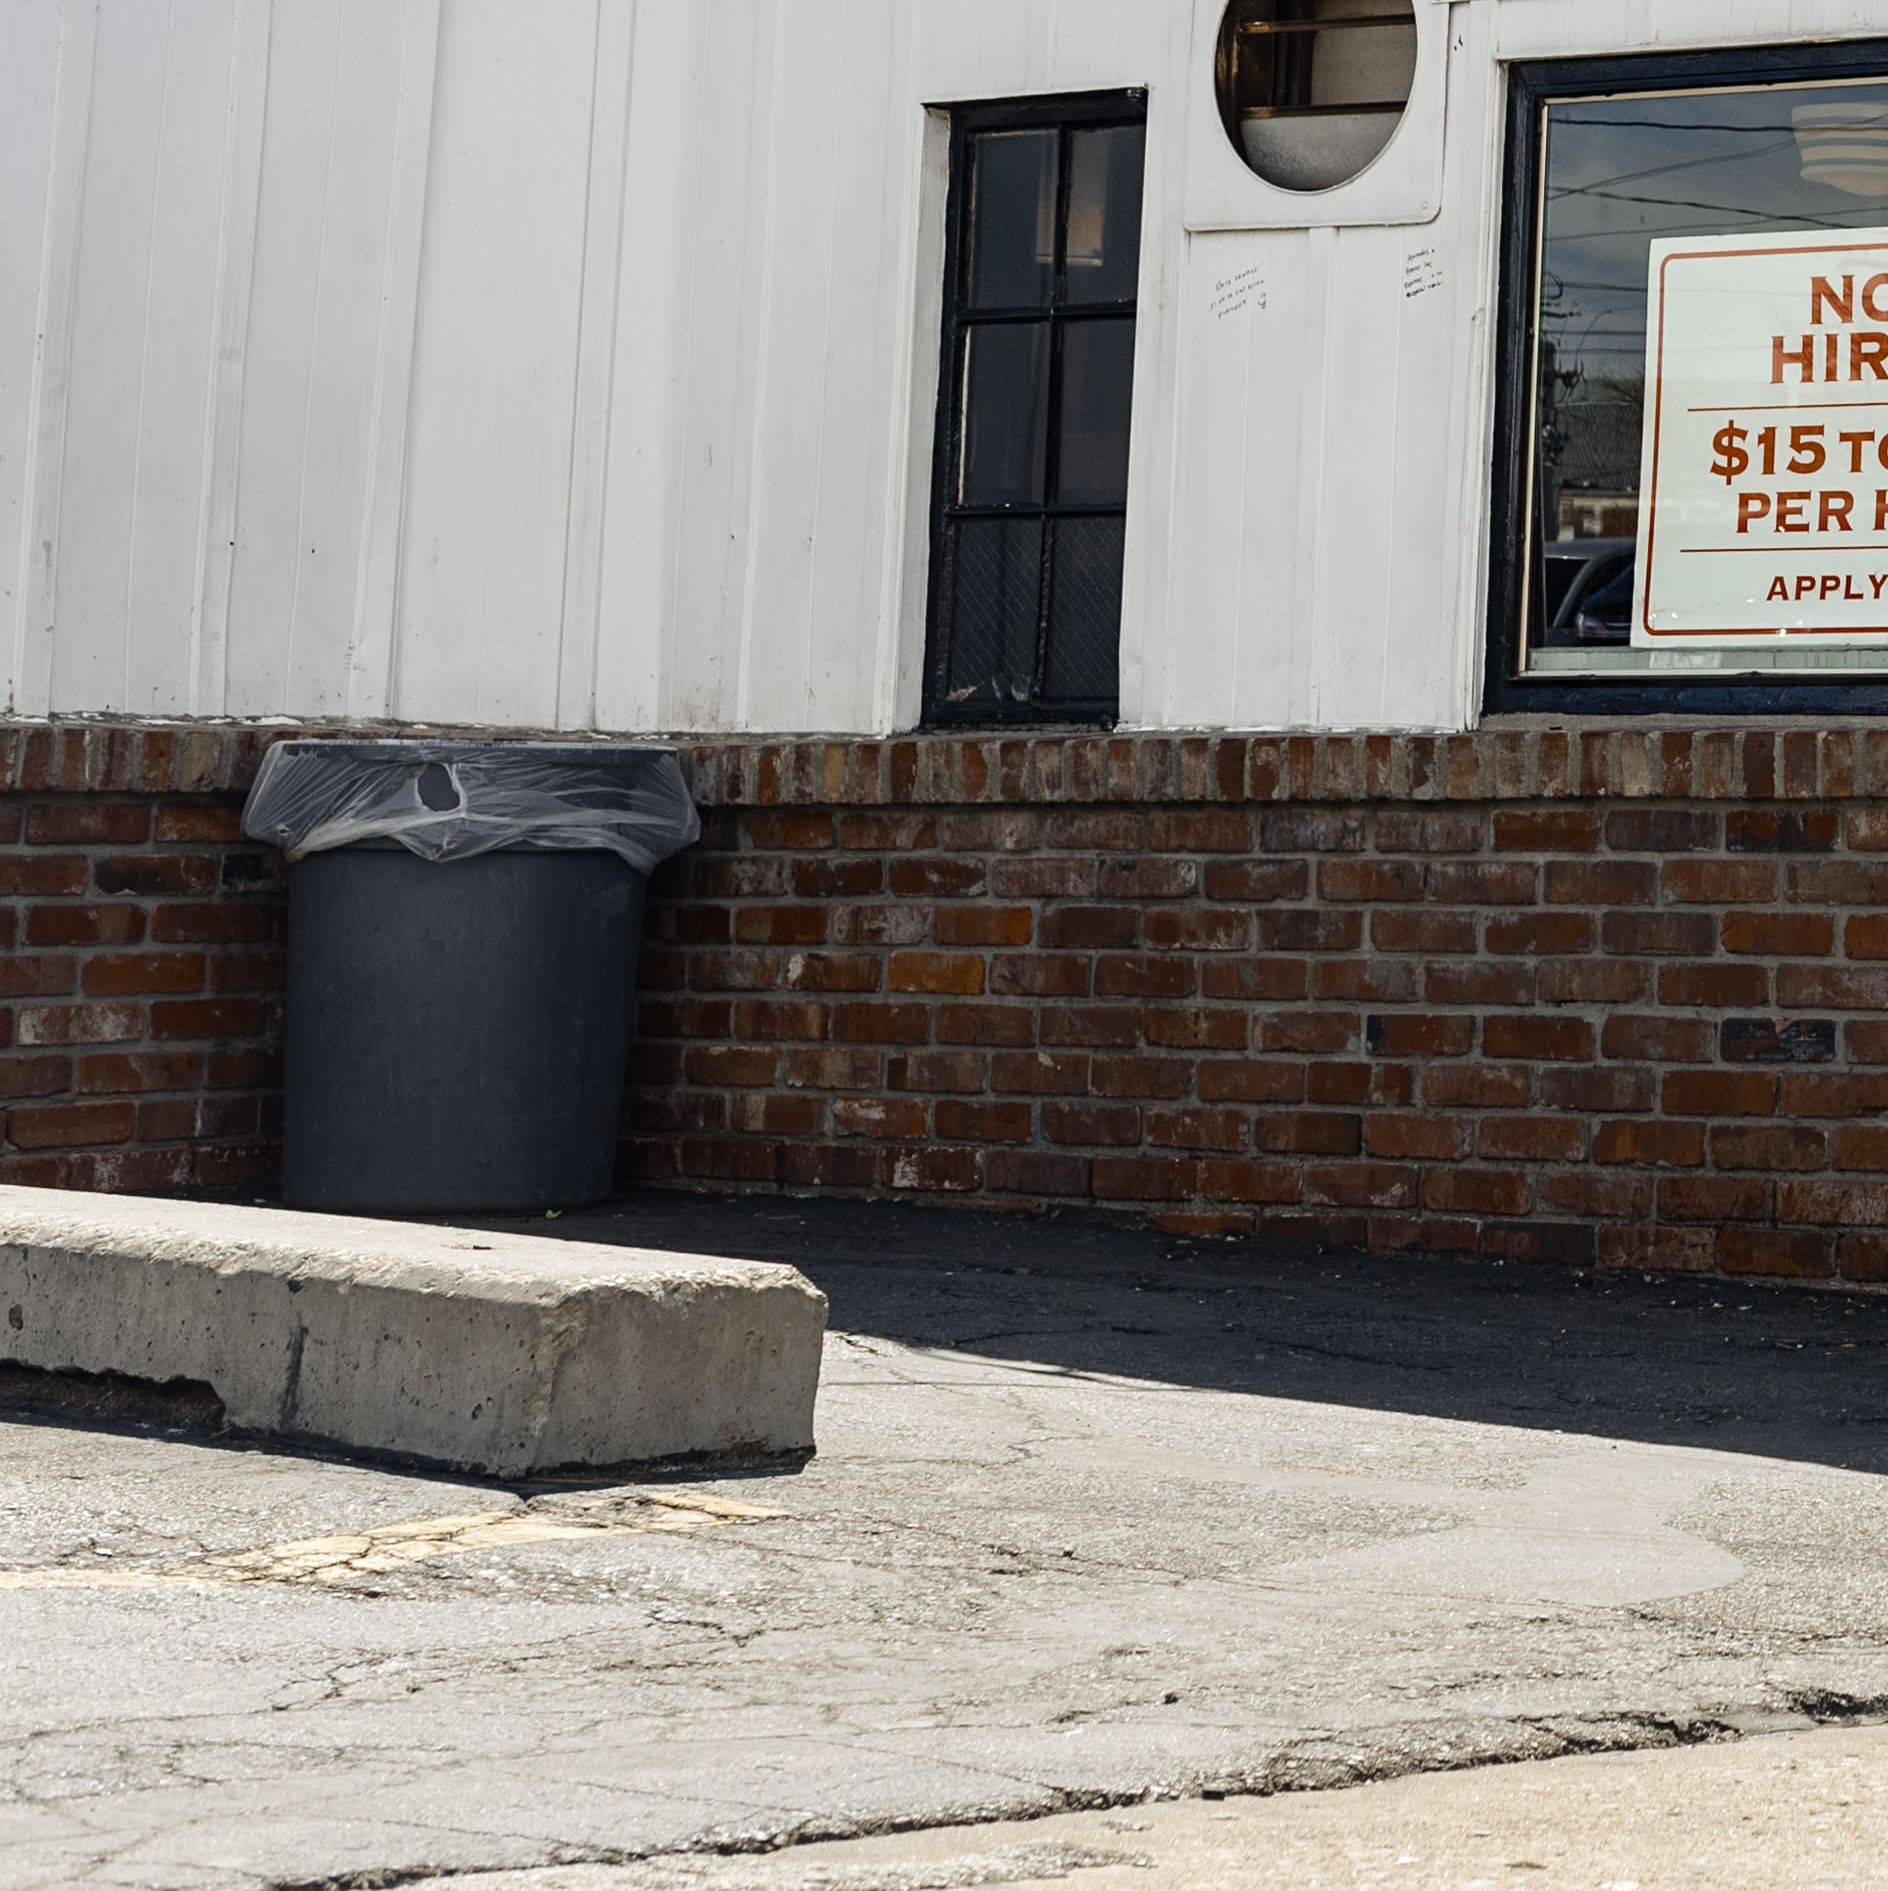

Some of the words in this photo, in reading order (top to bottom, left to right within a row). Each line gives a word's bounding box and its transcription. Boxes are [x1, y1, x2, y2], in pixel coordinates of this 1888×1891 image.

[1710, 420, 1827, 484] $15
[1735, 489, 1855, 534] PER
[1766, 573, 1888, 601] APPLY
